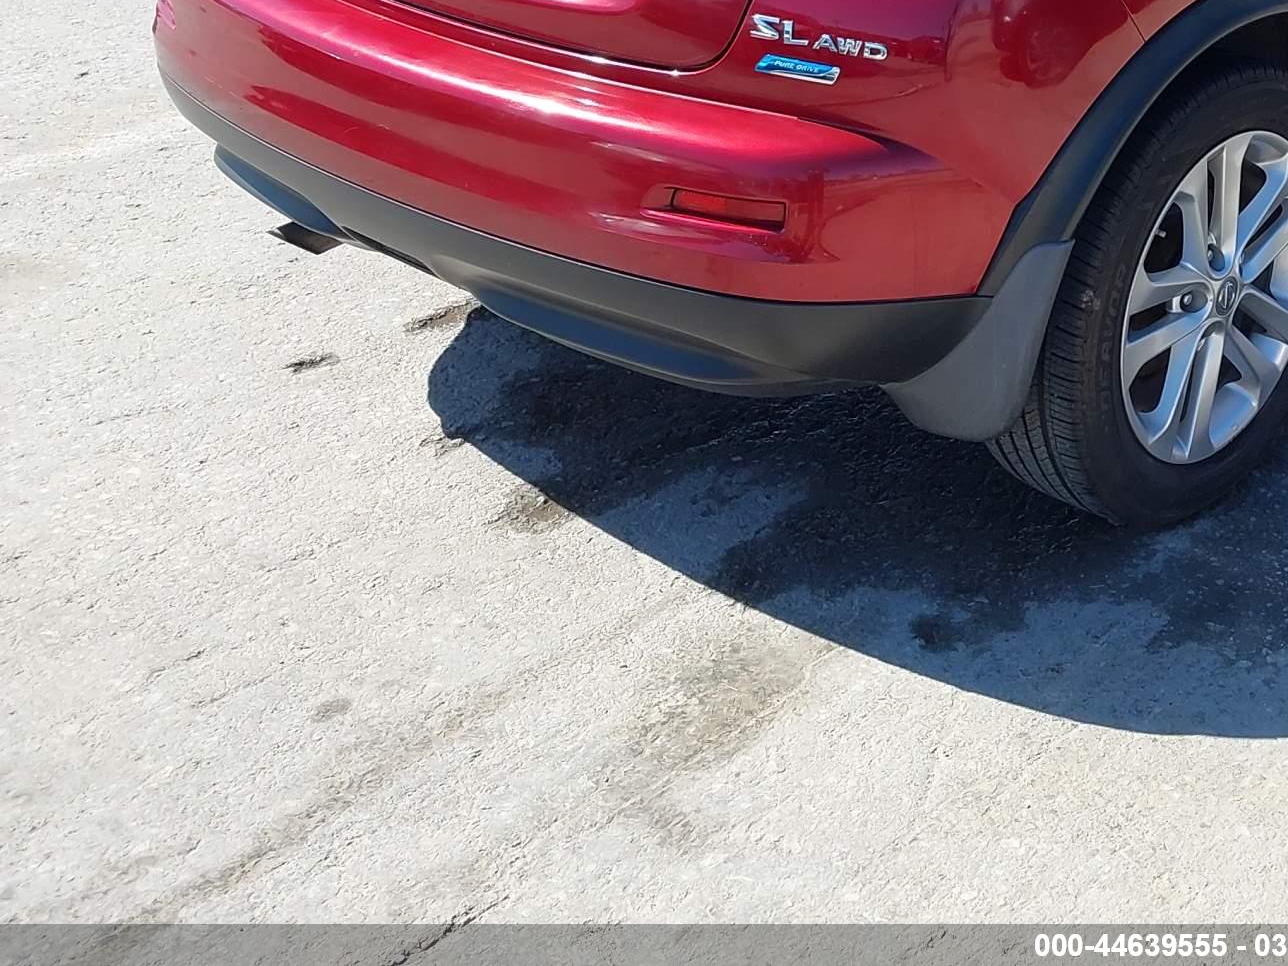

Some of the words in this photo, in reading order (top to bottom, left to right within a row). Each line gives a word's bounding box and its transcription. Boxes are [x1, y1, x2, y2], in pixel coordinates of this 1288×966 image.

[750, 13, 809, 46] SL
[812, 33, 887, 60] AWD
[772, 60, 794, 70] PURE
[796, 64, 820, 74] DRIVE
